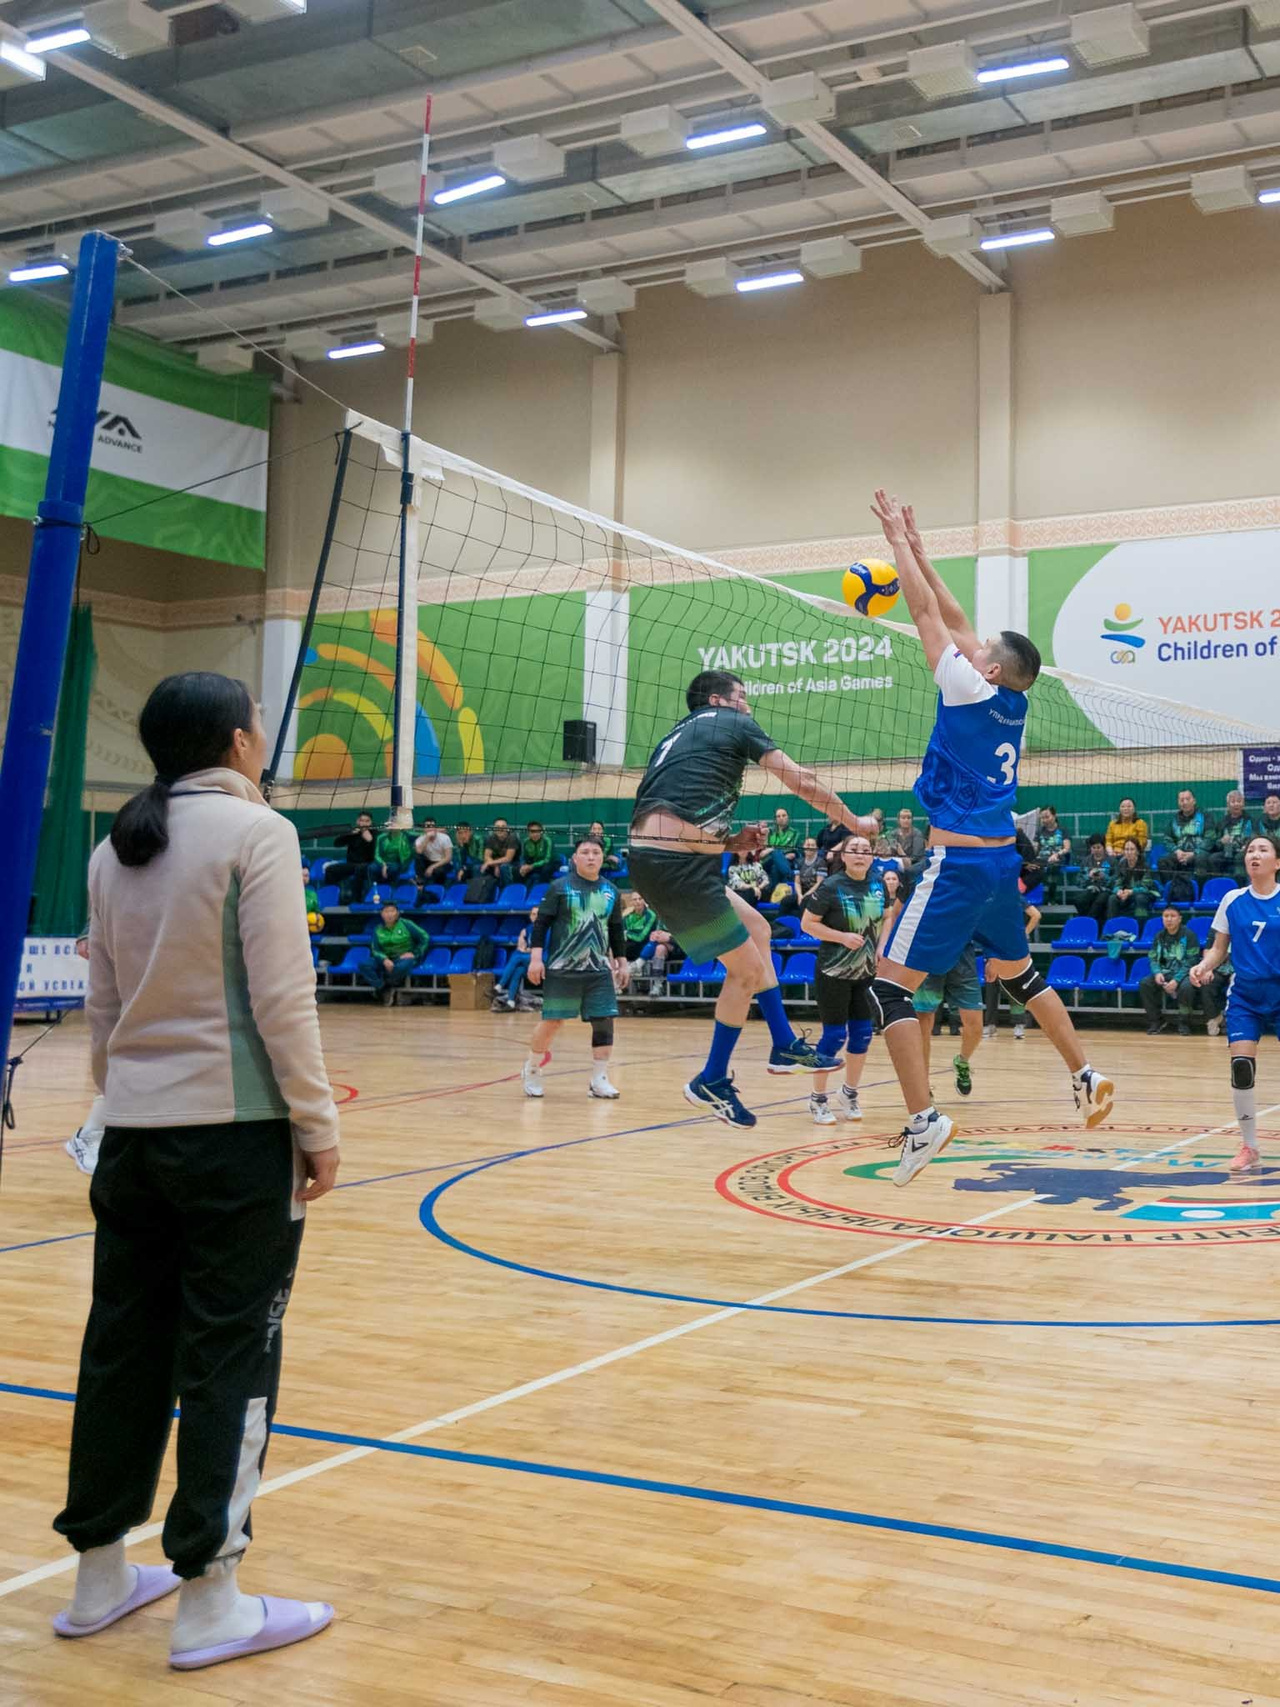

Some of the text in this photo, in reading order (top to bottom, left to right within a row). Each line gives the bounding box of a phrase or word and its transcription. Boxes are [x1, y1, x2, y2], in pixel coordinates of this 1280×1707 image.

[1158, 609, 1265, 635] YAKUTSK
[697, 634, 894, 672] YAKUTSK 2024
[1157, 640, 1248, 662] Children
[1254, 635, 1279, 657] of
[787, 677, 804, 694] of
[806, 677, 837, 692] Asia
[841, 675, 894, 691] Games
[987, 742, 1017, 786] 3
[1252, 921, 1267, 943] 7
[769, 1200, 1132, 1242] НАЦИОНАЛЬНЫХ
